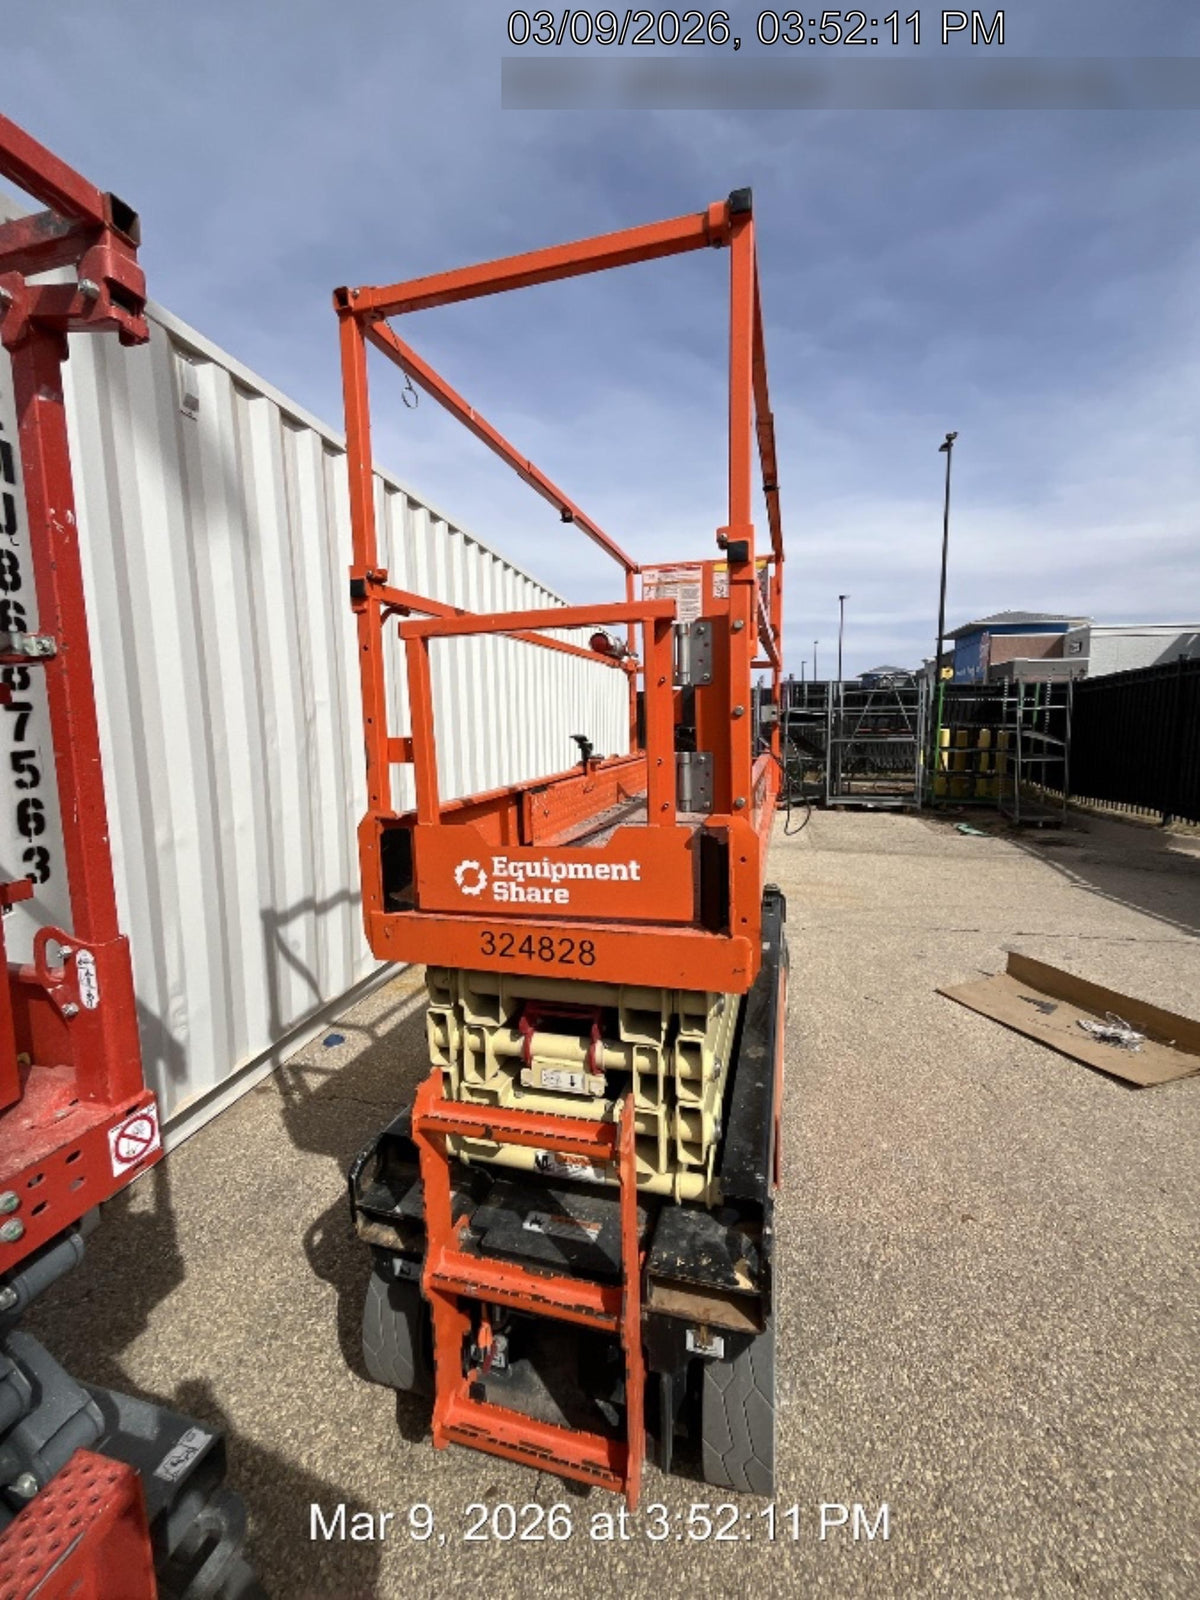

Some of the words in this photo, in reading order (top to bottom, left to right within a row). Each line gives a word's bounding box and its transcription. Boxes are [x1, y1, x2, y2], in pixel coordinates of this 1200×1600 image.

[491, 856, 641, 883] Equipment
[492, 881, 570, 904] Share
[480, 930, 597, 967] 324828
